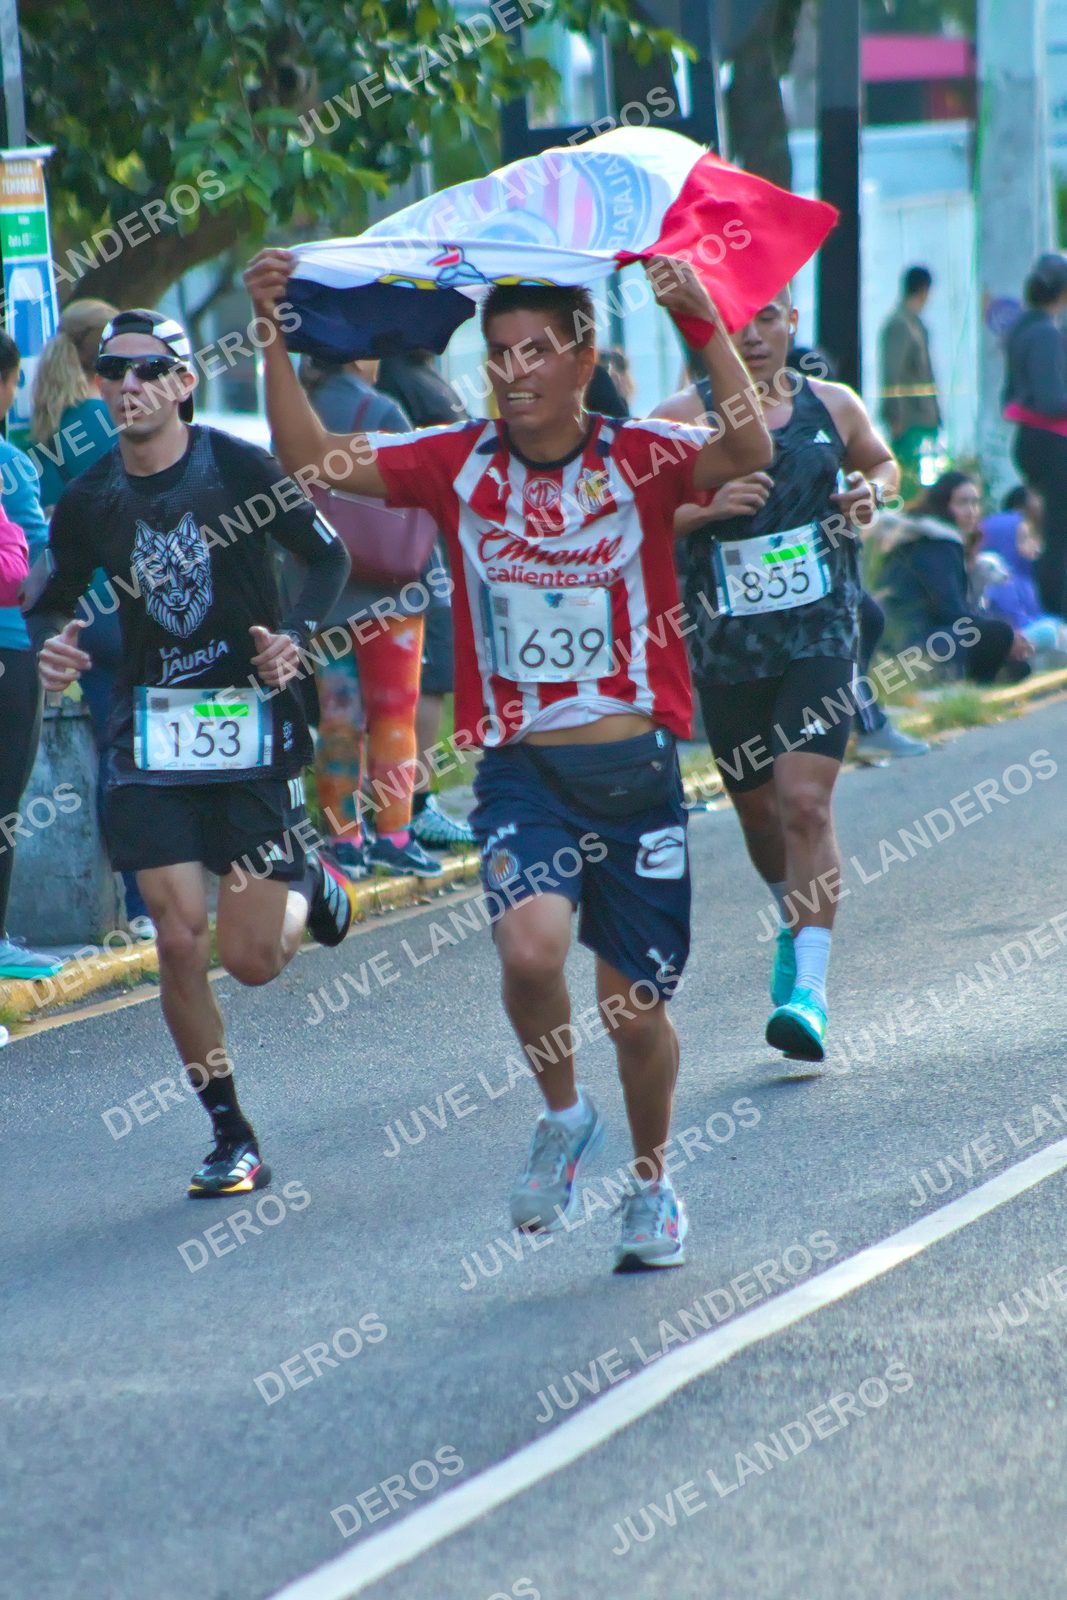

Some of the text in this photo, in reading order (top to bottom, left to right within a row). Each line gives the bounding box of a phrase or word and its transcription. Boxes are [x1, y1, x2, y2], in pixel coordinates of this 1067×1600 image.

[742, 560, 810, 603] 855
[158, 646, 181, 660] LA
[500, 628, 605, 669] 1639
[168, 720, 241, 758] 153
